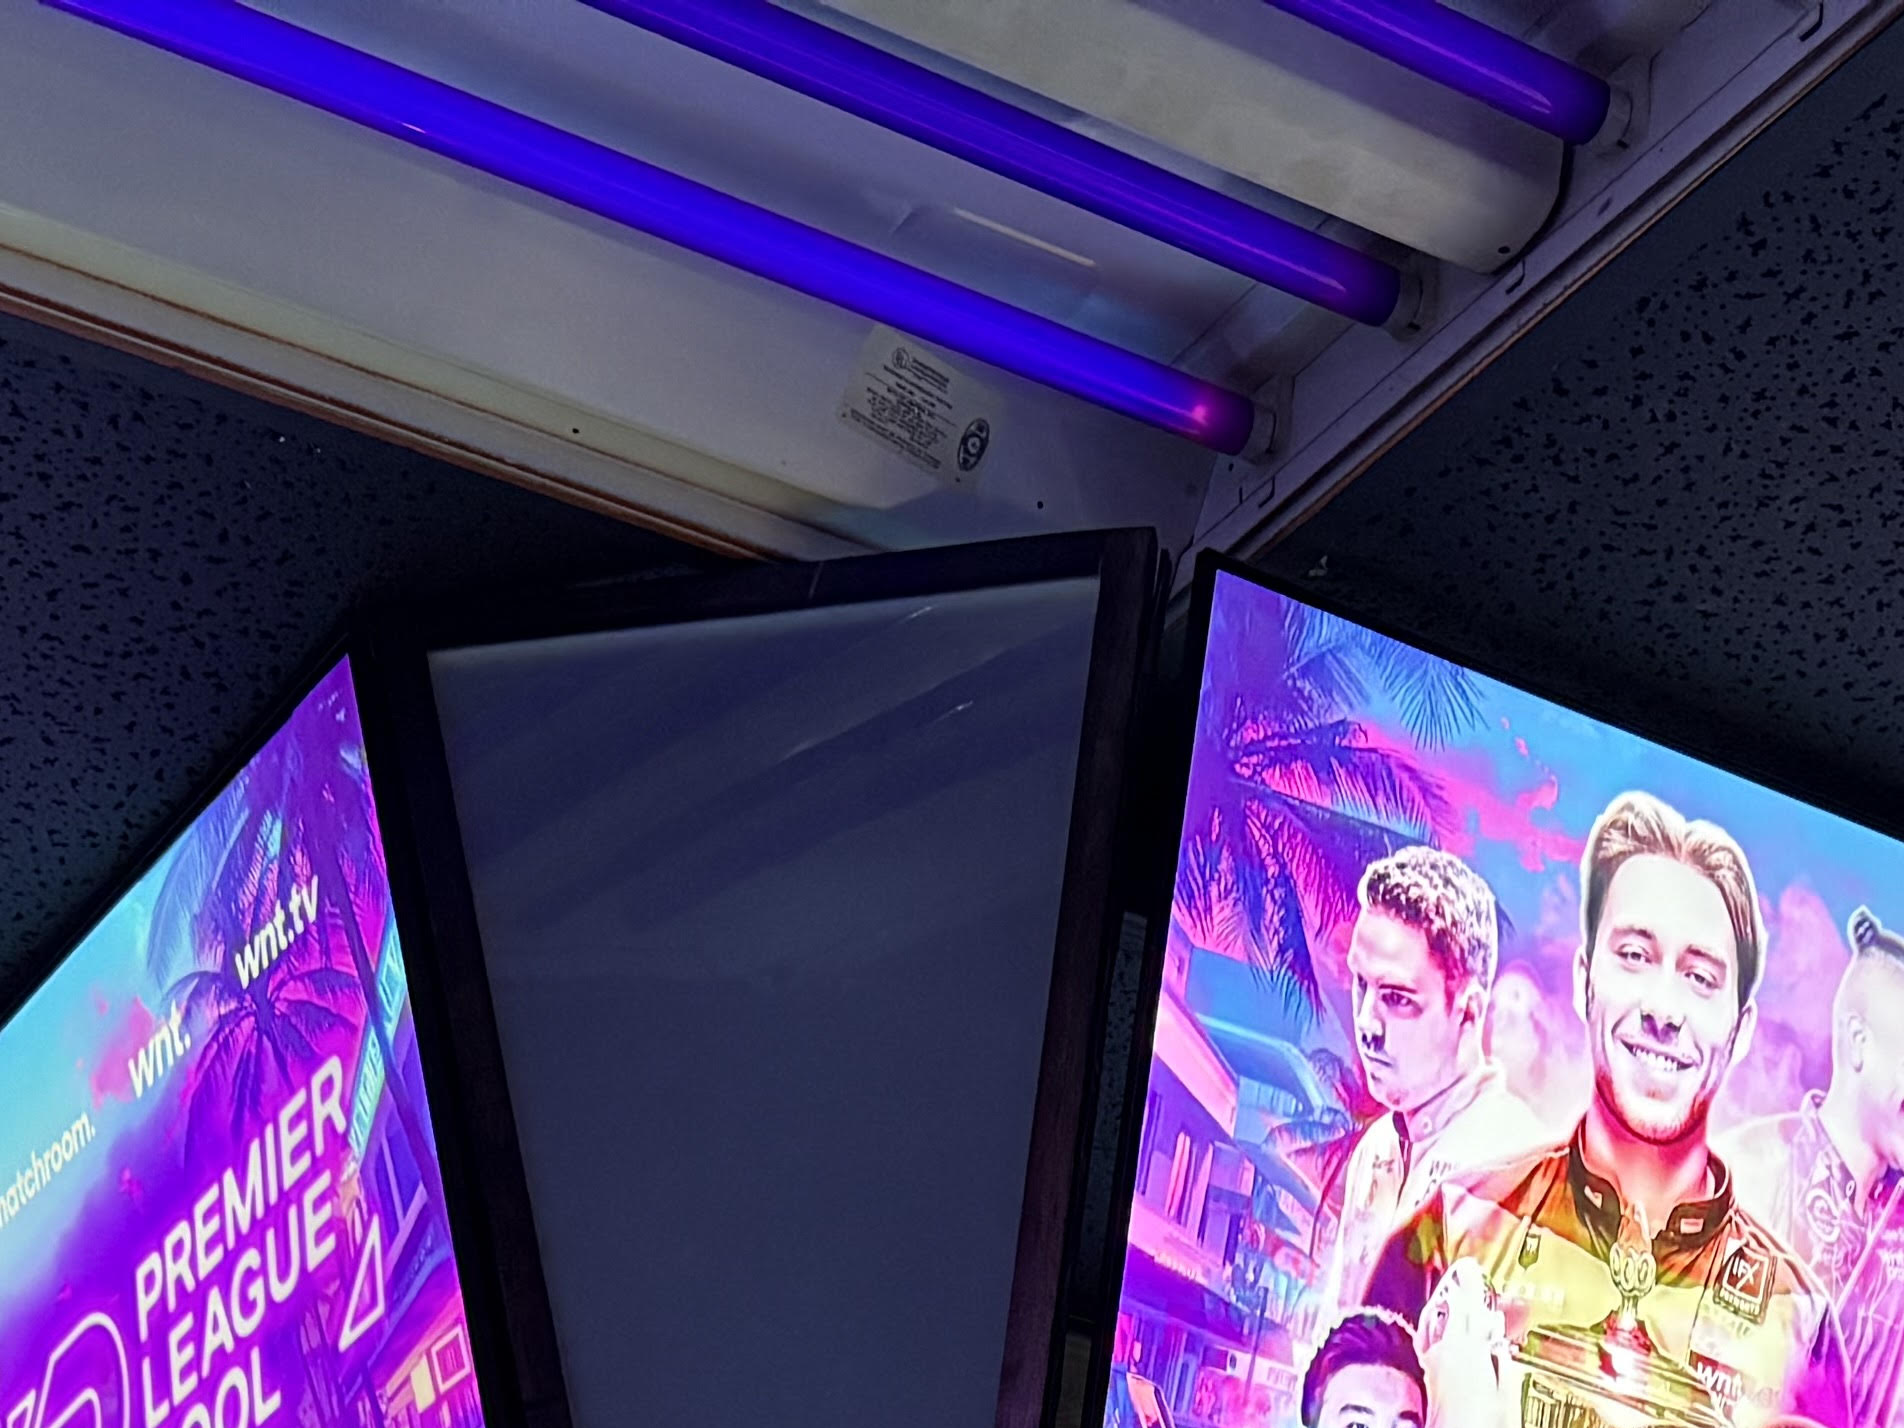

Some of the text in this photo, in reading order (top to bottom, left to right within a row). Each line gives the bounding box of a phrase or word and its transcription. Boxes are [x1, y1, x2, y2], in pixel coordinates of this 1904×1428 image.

[128, 1005, 191, 1098] wnt.
[233, 875, 320, 989] wnt.tv
[134, 1055, 347, 1341] PREMIER
